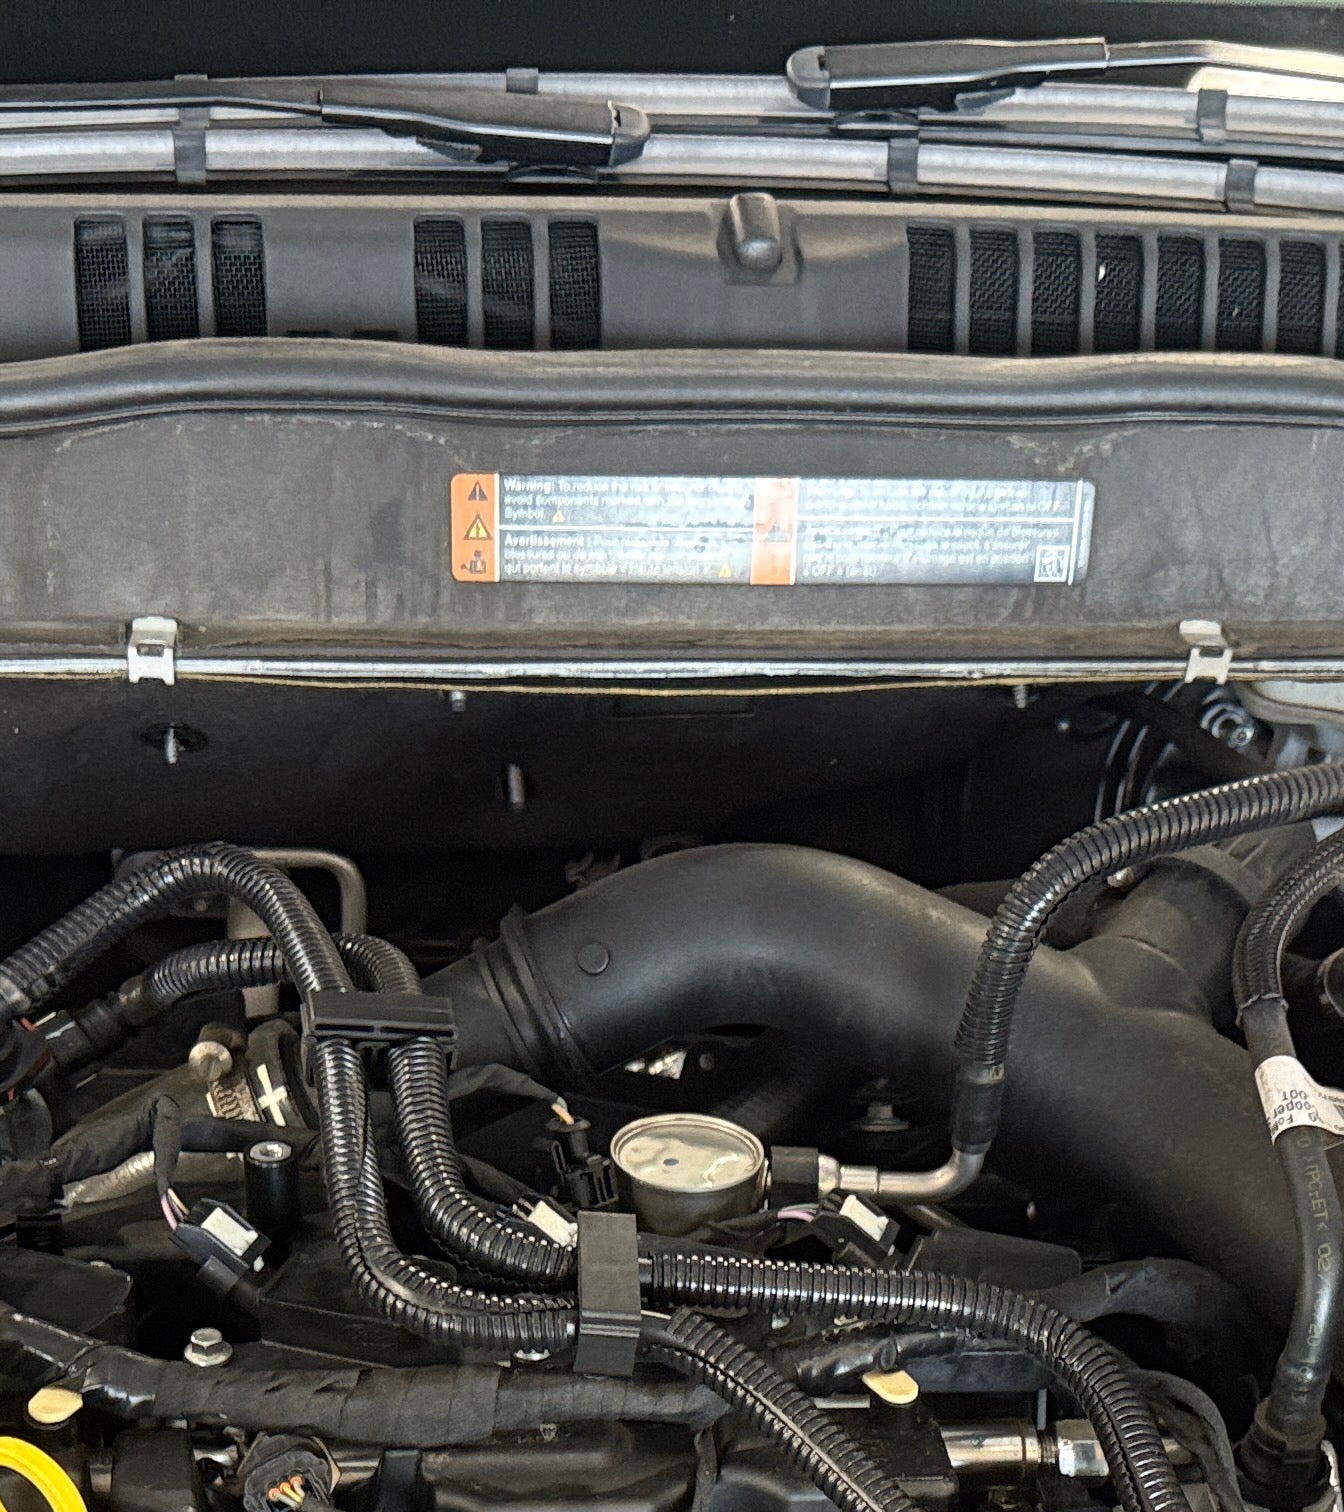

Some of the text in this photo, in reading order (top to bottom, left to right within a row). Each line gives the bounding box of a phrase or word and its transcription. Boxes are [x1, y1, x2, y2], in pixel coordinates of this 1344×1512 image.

[503, 478, 554, 494] Warning:
[503, 494, 533, 506] avoid
[535, 494, 599, 508] components
[503, 508, 545, 522] Symbol
[503, 533, 585, 548] Avertissement
